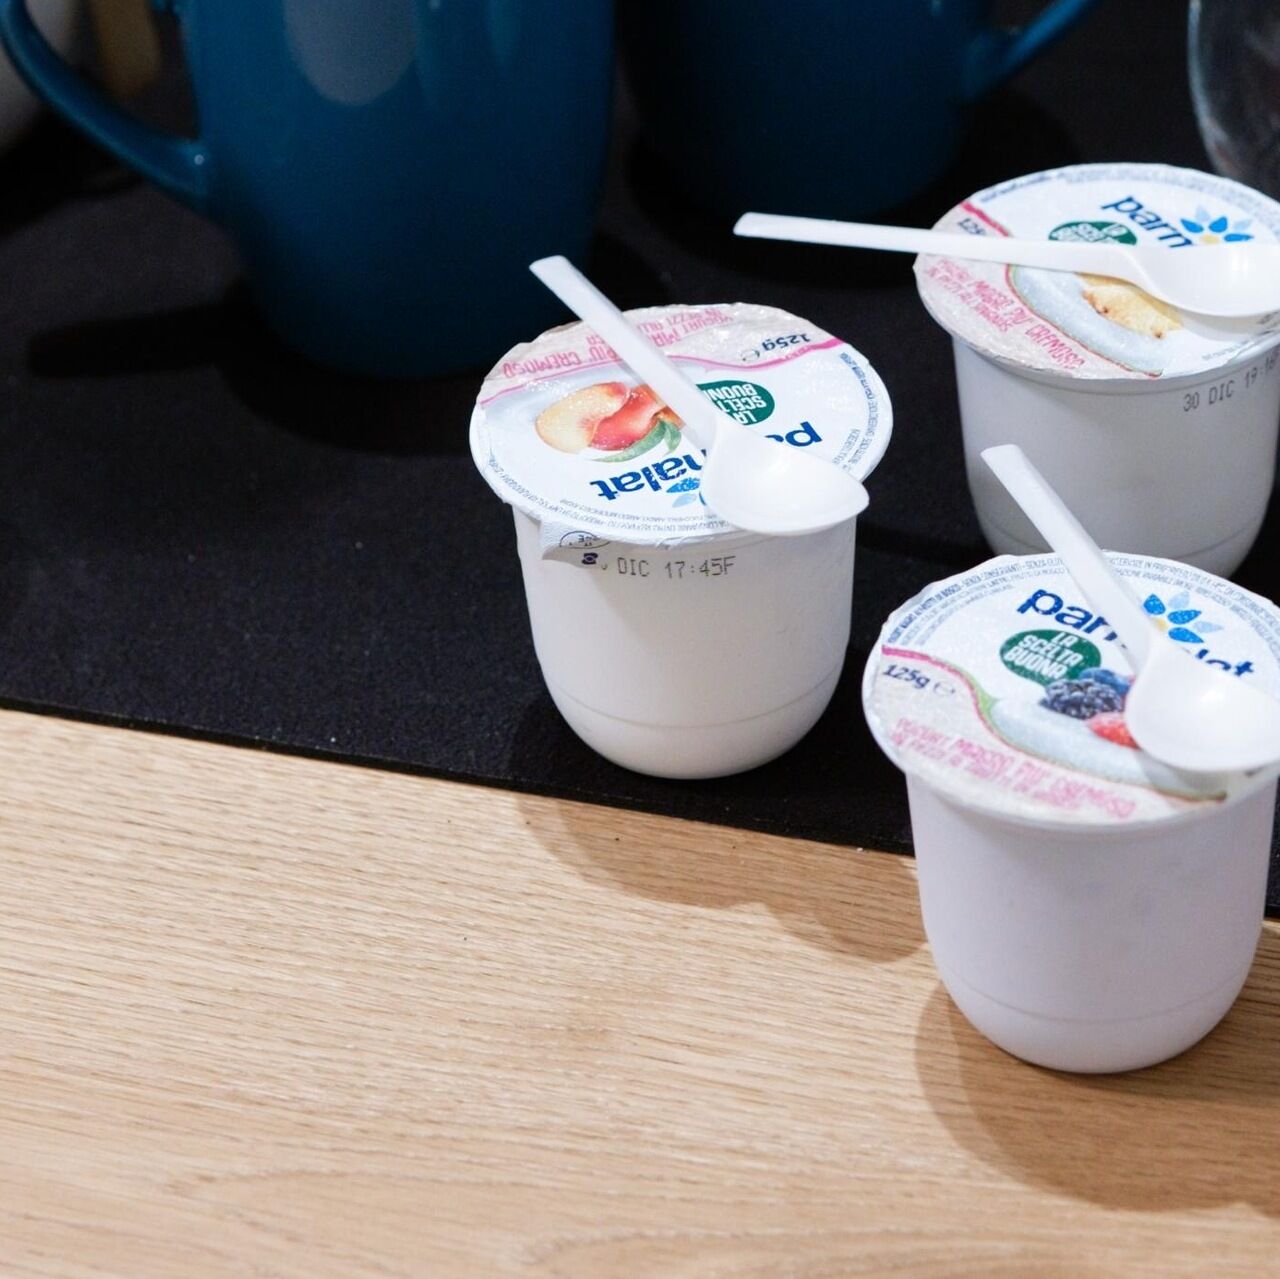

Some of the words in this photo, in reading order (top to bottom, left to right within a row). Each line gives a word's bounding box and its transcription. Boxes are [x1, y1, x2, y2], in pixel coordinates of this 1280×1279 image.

[637, 319, 665, 333] ALL
[761, 332, 812, 352] 125g
[502, 350, 582, 379] CREMOSO
[703, 382, 758, 401] BUON
[1182, 391, 1200, 412] 30
[1208, 379, 1235, 405] DIC
[715, 396, 767, 412] SCELT
[735, 410, 758, 425] LA
[589, 420, 823, 501] palat
[617, 556, 650, 577] DIC
[1053, 630, 1078, 646] LA
[1019, 634, 1083, 666] SCELTA
[1003, 645, 1069, 680] BUONA
[881, 663, 931, 690] 125g
